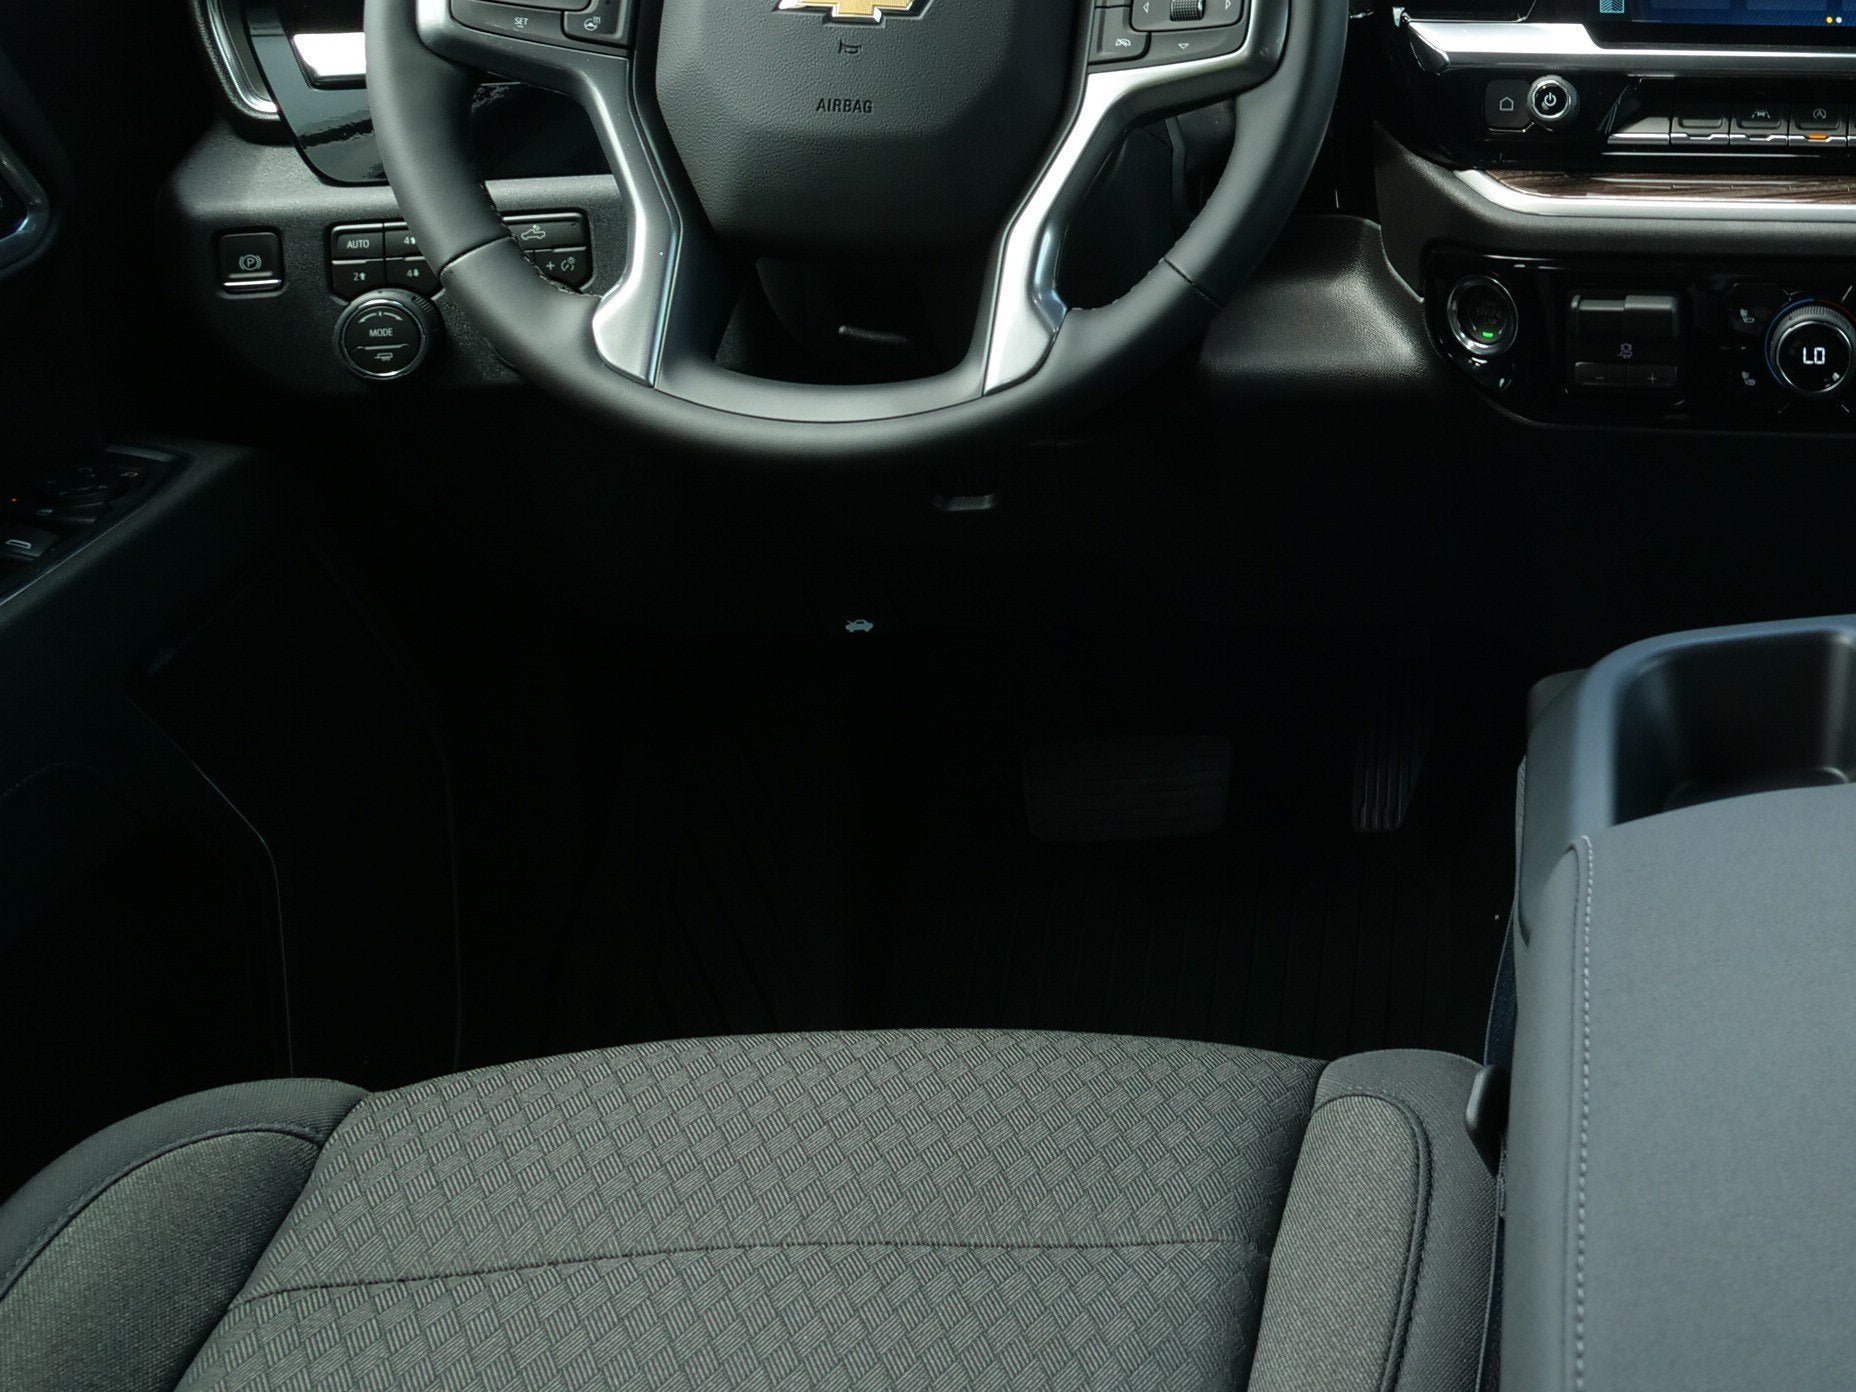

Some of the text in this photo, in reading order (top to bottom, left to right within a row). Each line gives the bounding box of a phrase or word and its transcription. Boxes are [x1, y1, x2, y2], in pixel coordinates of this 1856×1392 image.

[514, 17, 529, 26] SET
[815, 98, 873, 114] AIRBAG
[346, 239, 370, 249] AUTO
[369, 327, 393, 338] MODE
[1803, 347, 1825, 365] LO
